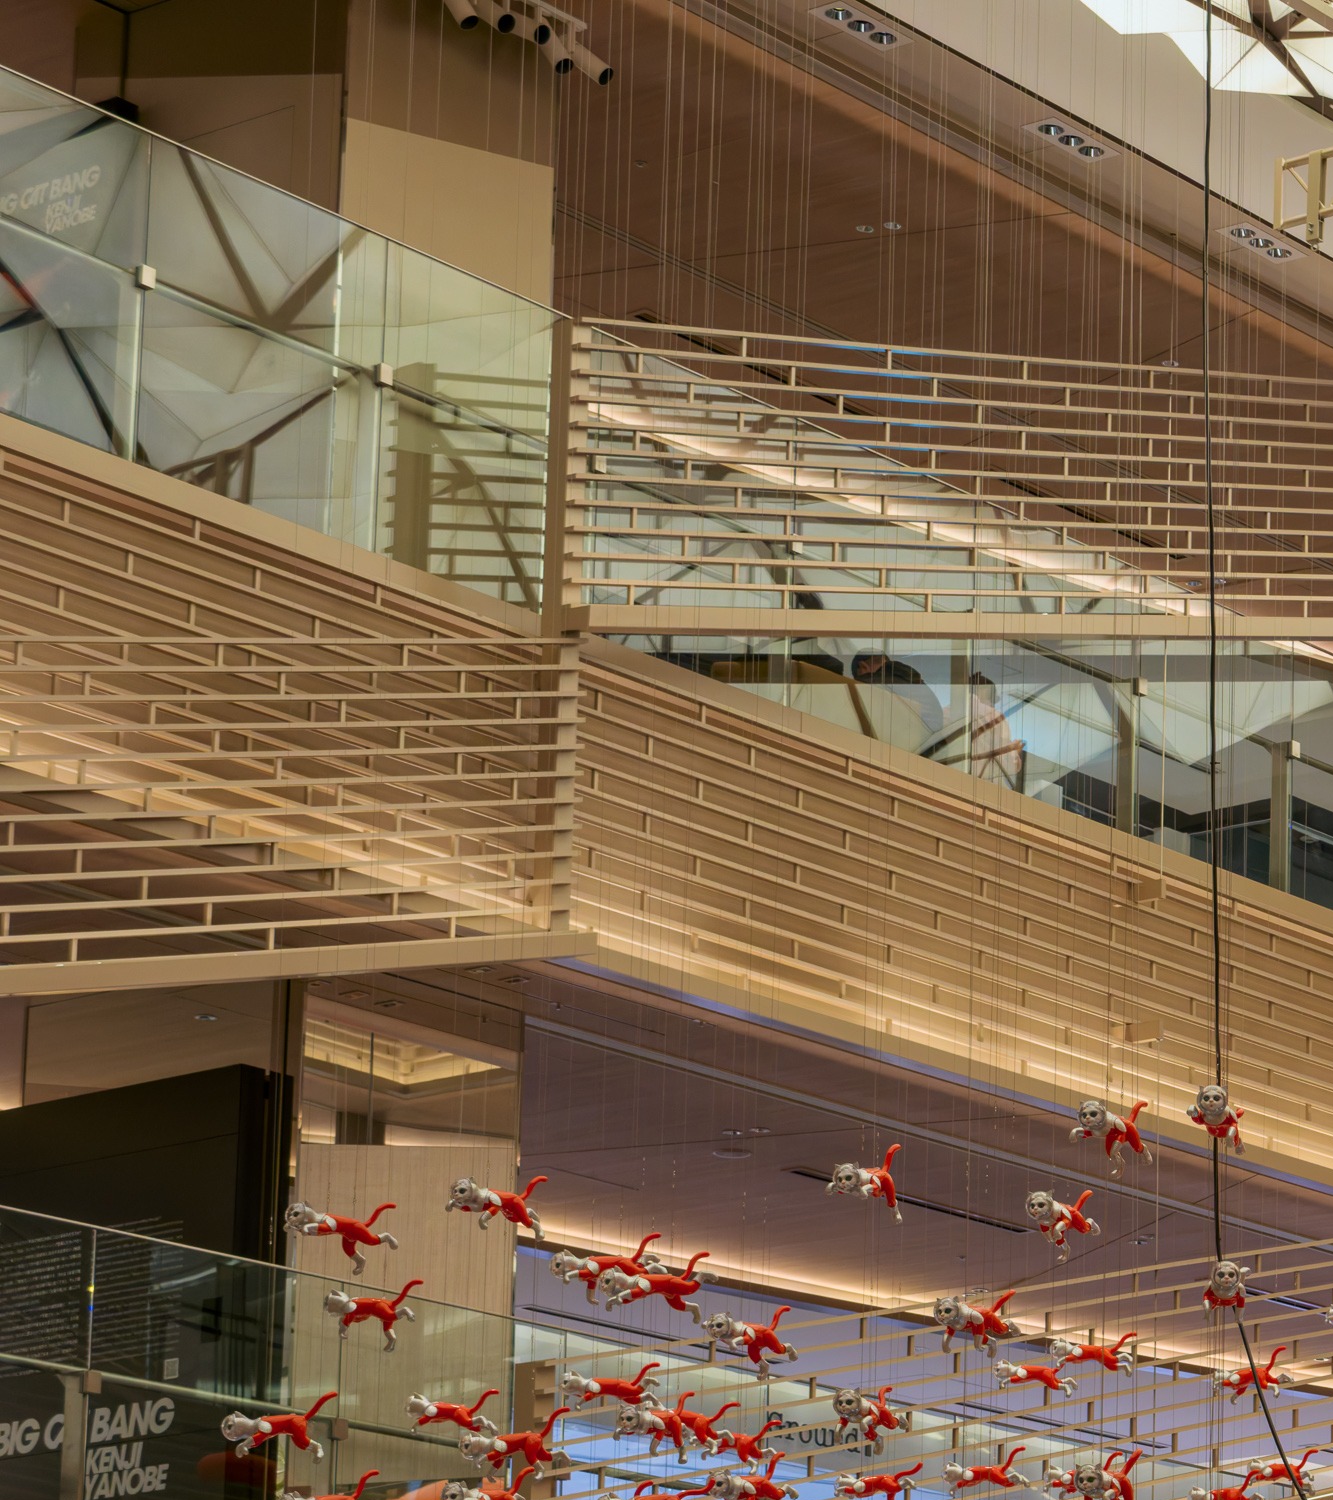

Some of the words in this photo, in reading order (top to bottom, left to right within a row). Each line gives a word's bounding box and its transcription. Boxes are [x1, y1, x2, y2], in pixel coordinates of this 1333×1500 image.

[48, 165, 101, 200] BANG
[0, 1417, 41, 1458] BIG
[90, 1397, 175, 1444] BANG
[86, 1441, 144, 1475] KENJI
[84, 1463, 170, 1500] YANOBE
